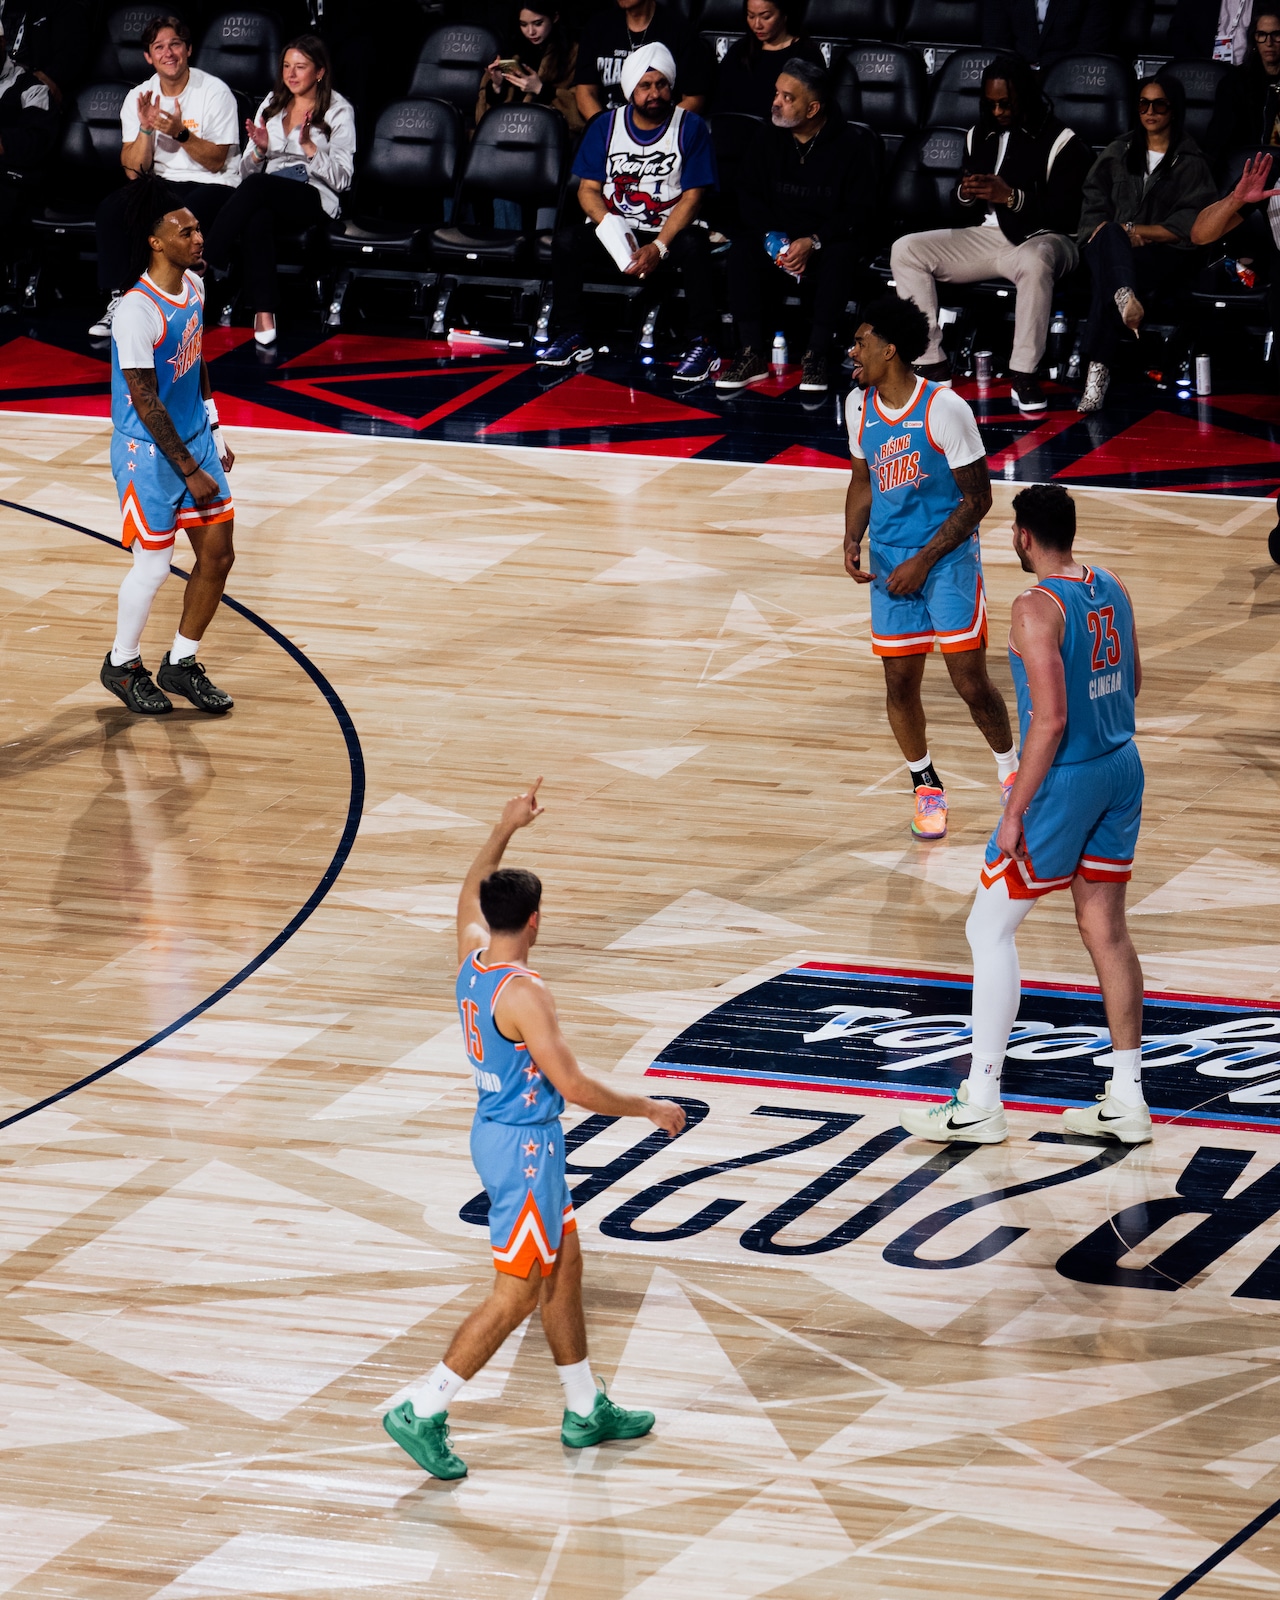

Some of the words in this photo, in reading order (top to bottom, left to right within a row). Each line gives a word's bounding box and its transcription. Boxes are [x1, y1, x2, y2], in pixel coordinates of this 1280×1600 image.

[90, 100, 121, 111] DOM
[925, 138, 960, 148] NTUIT
[880, 433, 911, 459] RISING
[878, 450, 921, 493] STARS
[1087, 605, 1122, 672] 23
[460, 997, 484, 1064] 15
